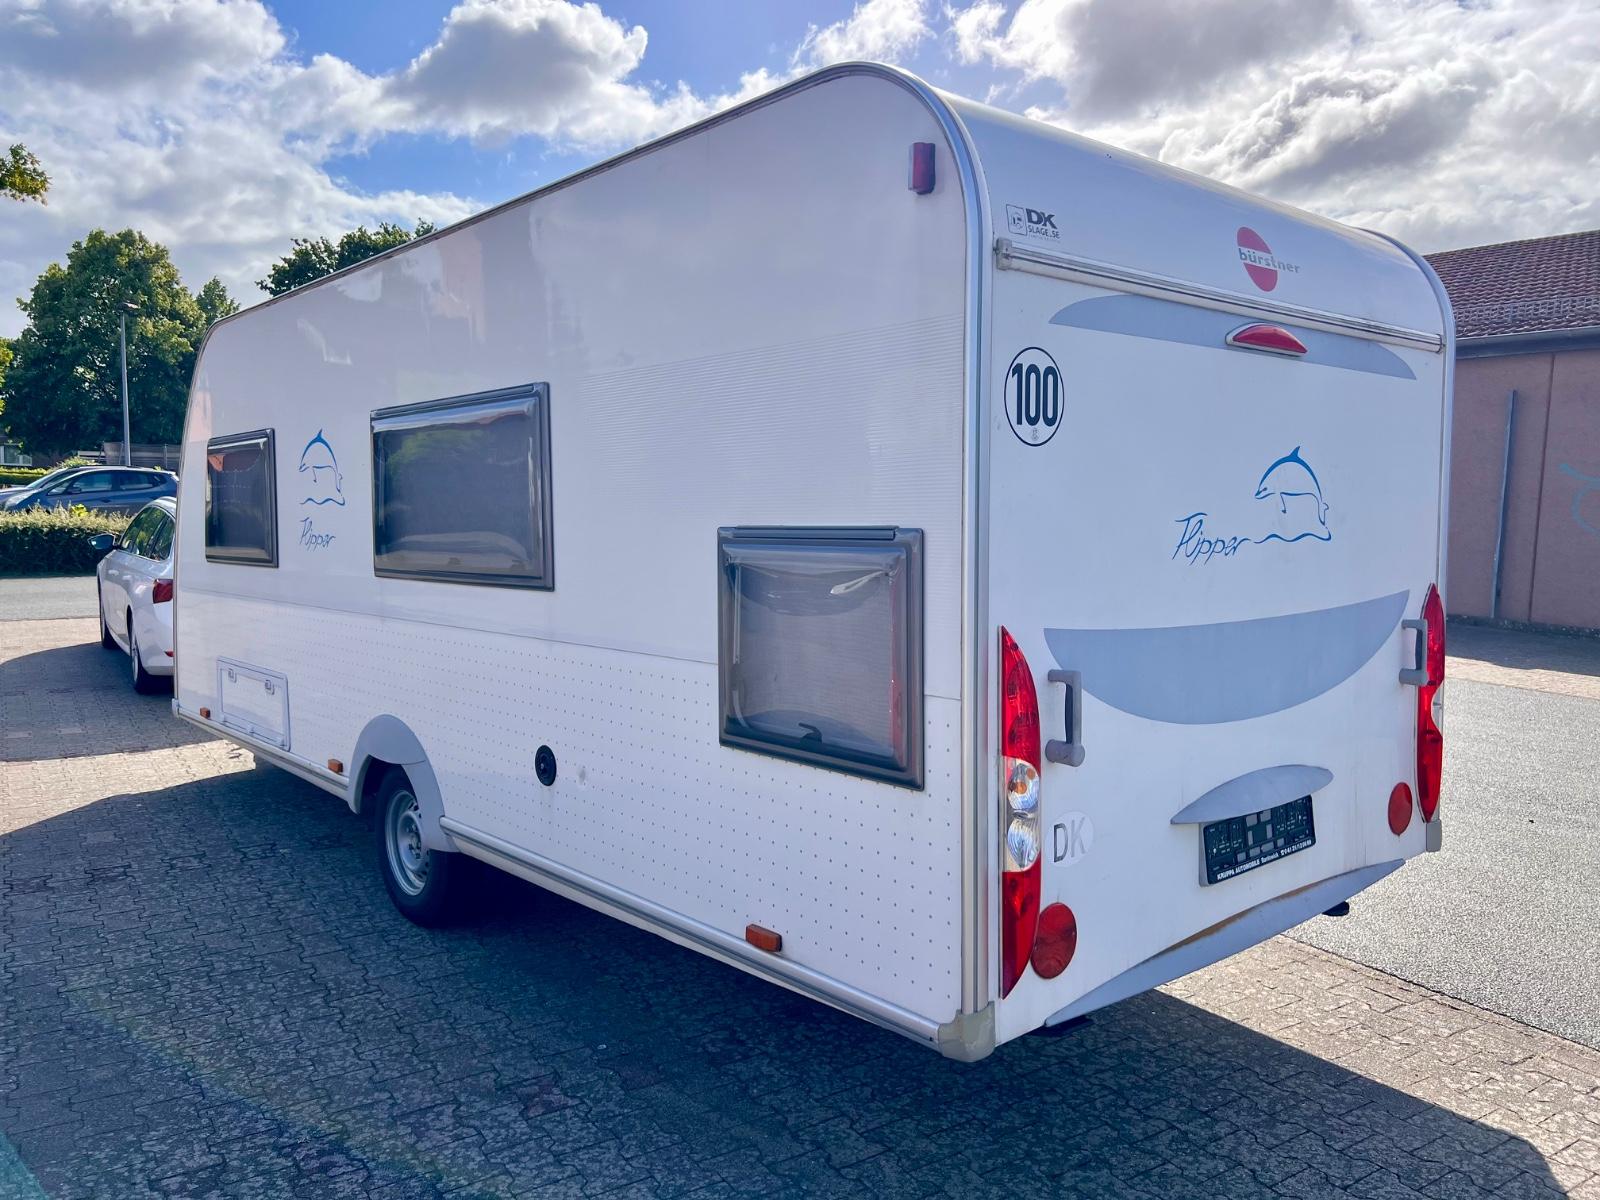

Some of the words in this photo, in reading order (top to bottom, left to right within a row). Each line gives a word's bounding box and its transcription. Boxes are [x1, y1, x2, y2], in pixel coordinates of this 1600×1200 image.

[1026, 208, 1058, 230] DK
[1239, 248, 1300, 273] bürstner
[1012, 363, 1059, 427] 100
[300, 517, 336, 552] Flipper
[1172, 512, 1251, 566] Flipper
[1053, 816, 1086, 863] DK
